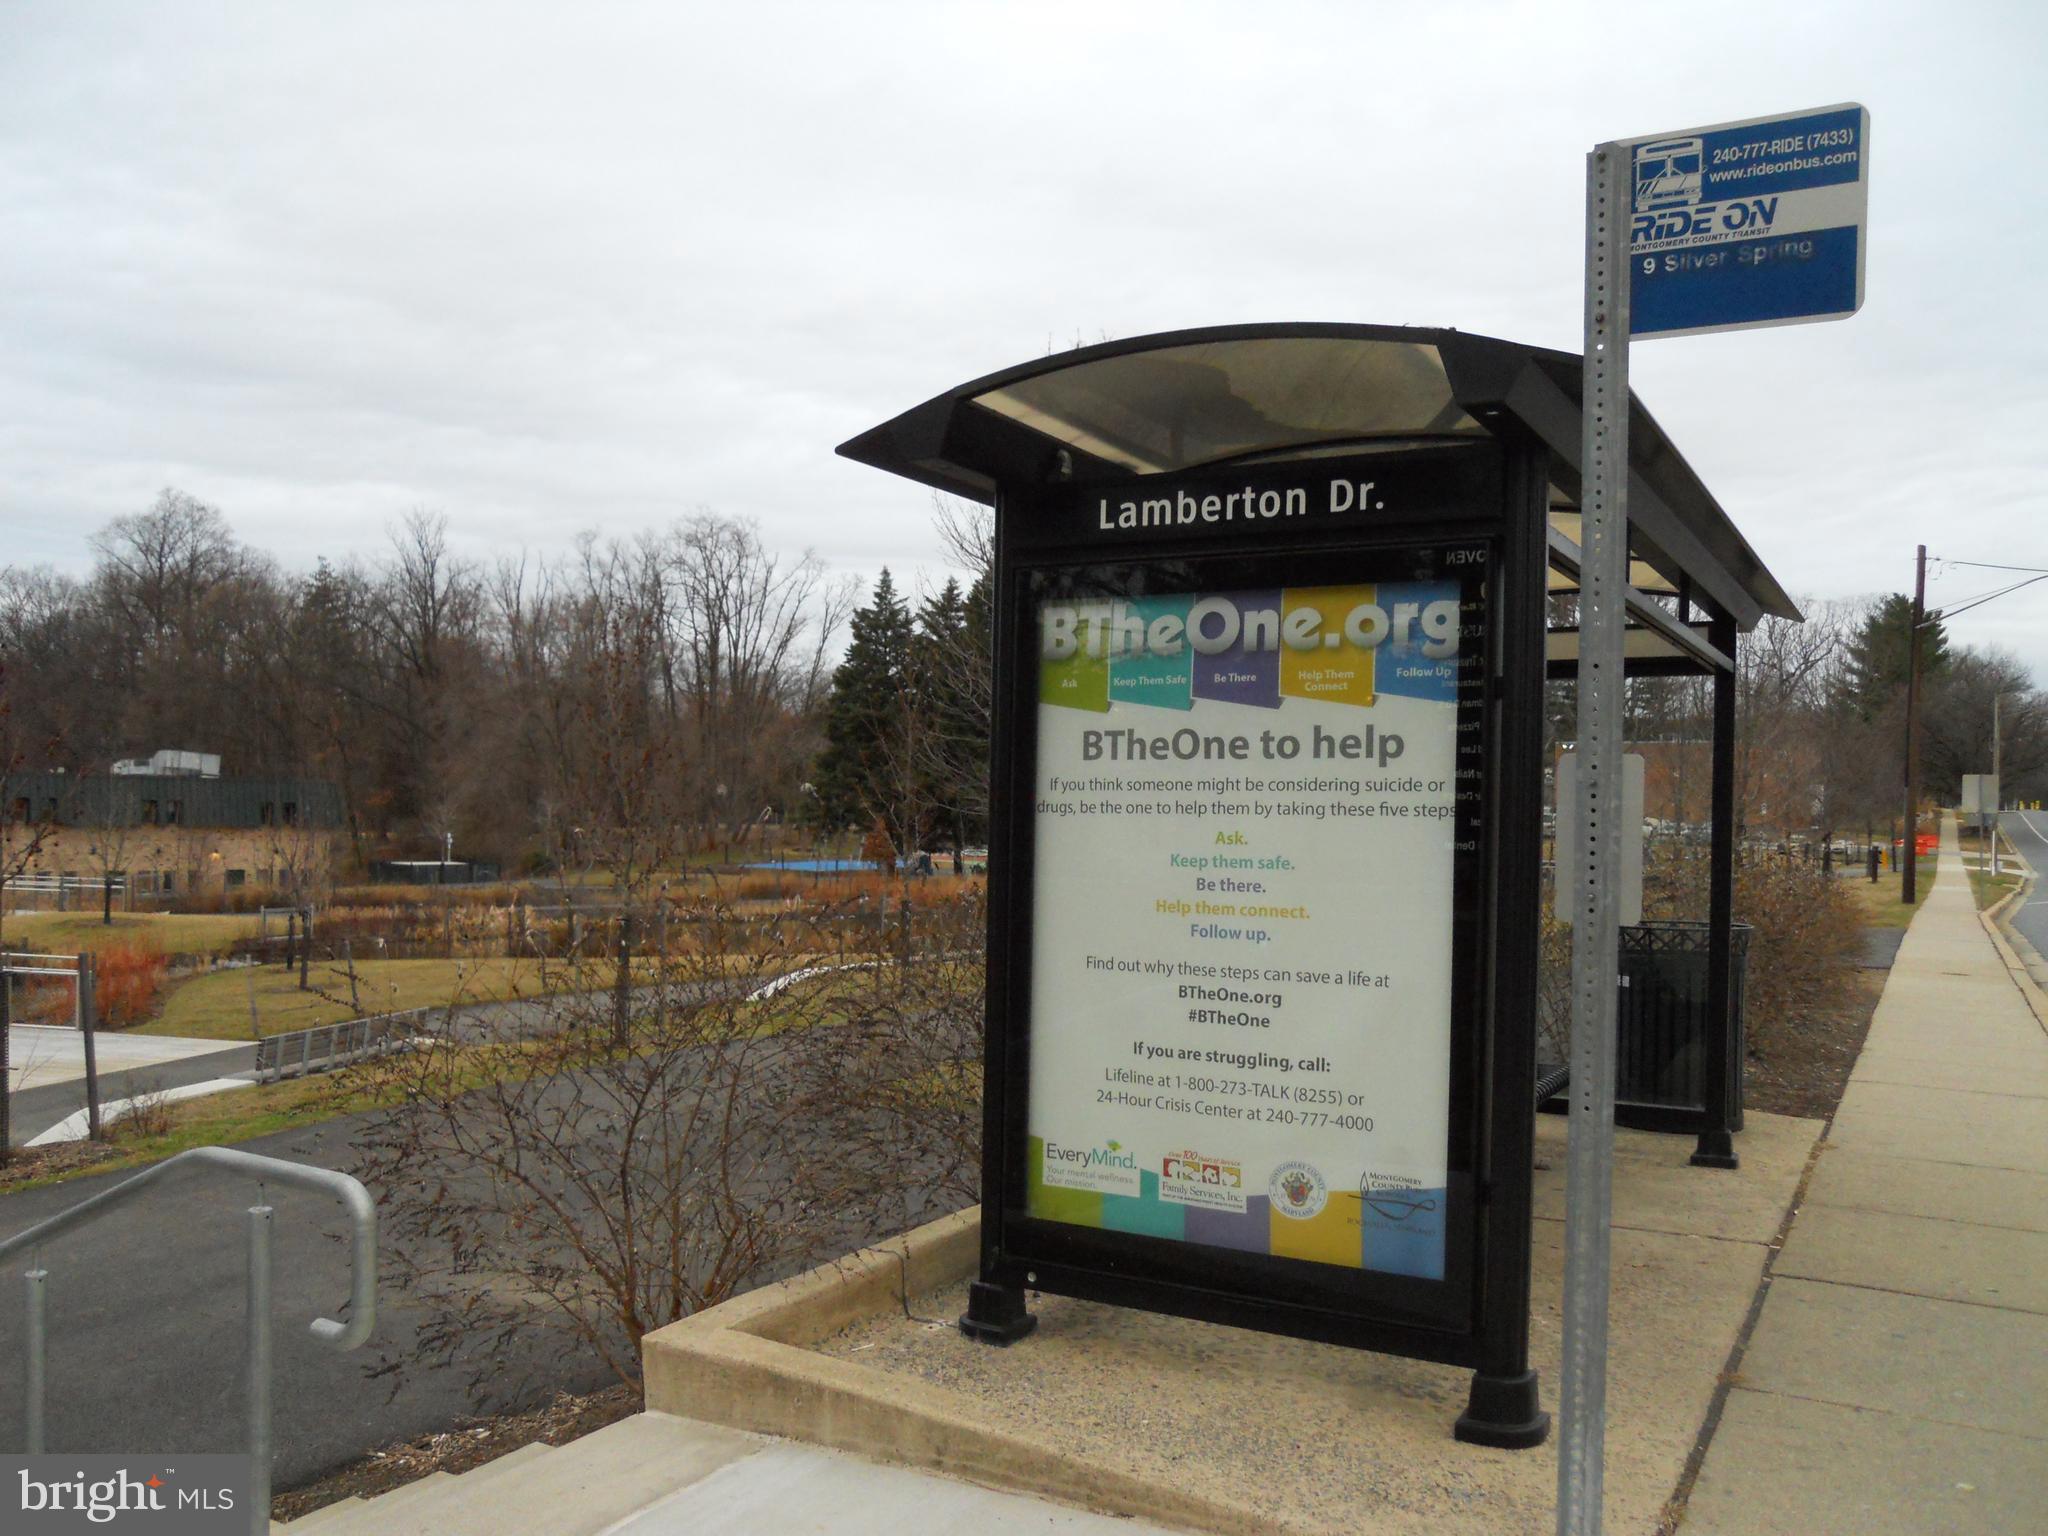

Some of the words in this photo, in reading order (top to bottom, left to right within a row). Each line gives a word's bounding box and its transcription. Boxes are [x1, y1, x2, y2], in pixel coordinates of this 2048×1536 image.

[1713, 136, 1804, 164] 240-777-RIDE
[1807, 128, 1853, 150] (7433)
[1709, 151, 1857, 183] www.rideonbus.com
[1722, 197, 1778, 231] ON
[1692, 233, 1730, 244] COUNTY
[1732, 227, 1771, 238] TRANSIT
[1643, 258, 1656, 274] 9
[1664, 251, 1729, 272] Silver
[1738, 240, 1813, 265] Spring
[1100, 486, 1306, 529] Lamberton
[1330, 479, 1385, 513] Dr.
[1043, 596, 1460, 660] BTheOne.org
[1113, 676, 1136, 687] Keep
[1139, 676, 1164, 685] Them
[1165, 675, 1187, 685] Safe
[1214, 673, 1226, 682] Be
[1228, 672, 1257, 682] There
[1298, 670, 1322, 682] Help
[1324, 669, 1355, 680] Them
[1396, 667, 1433, 678] Follow
[1435, 667, 1452, 678] Up
[1062, 679, 1078, 688] Ask
[1304, 681, 1348, 692] Connect
[1083, 728, 1249, 761] BTheOne
[1260, 730, 1300, 760] to
[1313, 724, 1405, 768] help
[1050, 778, 1059, 791] If
[1061, 780, 1085, 794] you
[1089, 778, 1123, 791] think
[1127, 781, 1192, 791] someone
[1197, 777, 1241, 795] might
[1245, 777, 1264, 792] be
[1268, 777, 1360, 796] considering
[1365, 777, 1423, 793] suicide
[1427, 781, 1445, 792] or
[1037, 800, 1076, 817] drugs,
[1080, 800, 1097, 814] be
[1100, 801, 1122, 814] the
[1126, 804, 1152, 815] one
[1157, 802, 1171, 815] to
[1175, 800, 1207, 818] help
[1212, 801, 1249, 815] them
[1255, 801, 1272, 819] by
[1277, 802, 1325, 819] taking
[1330, 802, 1375, 817] these
[1380, 801, 1408, 817] five
[1413, 803, 1456, 820] steps
[1215, 831, 1248, 845] Ask.
[1170, 853, 1208, 871] Keep
[1212, 854, 1253, 869] them
[1258, 855, 1295, 870] safe.
[1196, 877, 1216, 891] Be
[1220, 878, 1266, 893] there.
[1156, 899, 1191, 917] Help
[1195, 900, 1235, 916] them
[1239, 904, 1310, 919] connect.
[1190, 924, 1241, 940] Follow
[1246, 930, 1271, 944] up.
[1086, 956, 1114, 970] Find
[1117, 959, 1141, 972] out
[1144, 960, 1174, 977] why
[1177, 961, 1216, 977] these
[1220, 965, 1259, 982] steps
[1263, 970, 1291, 981] can
[1296, 971, 1330, 984] save
[1334, 974, 1343, 985] a
[1348, 970, 1370, 986] life
[1374, 974, 1390, 988] at
[1179, 985, 1282, 1008] BTheOne.org
[1188, 1009, 1270, 1027] #BTheOne
[1134, 1041, 1144, 1054] If
[1147, 1045, 1174, 1059] you
[1177, 1049, 1202, 1061] are
[1205, 1050, 1294, 1072] struggling,
[1298, 1057, 1331, 1072] call:
[1105, 1067, 1154, 1086] Lifeline
[1158, 1076, 1171, 1088] at
[1176, 1075, 1290, 1100] 1-800-273-TALK
[1293, 1087, 1343, 1106] (8255)
[1347, 1094, 1365, 1106] or
[1097, 1089, 1152, 1108] 24-Hour
[1155, 1096, 1191, 1113] Crisis
[1195, 1101, 1243, 1119] Center
[1247, 1108, 1261, 1121] at
[1266, 1108, 1374, 1132] 240-777-4000
[1047, 1143, 1137, 1170] EveryMind.
[1162, 1181, 1188, 1194] Family
